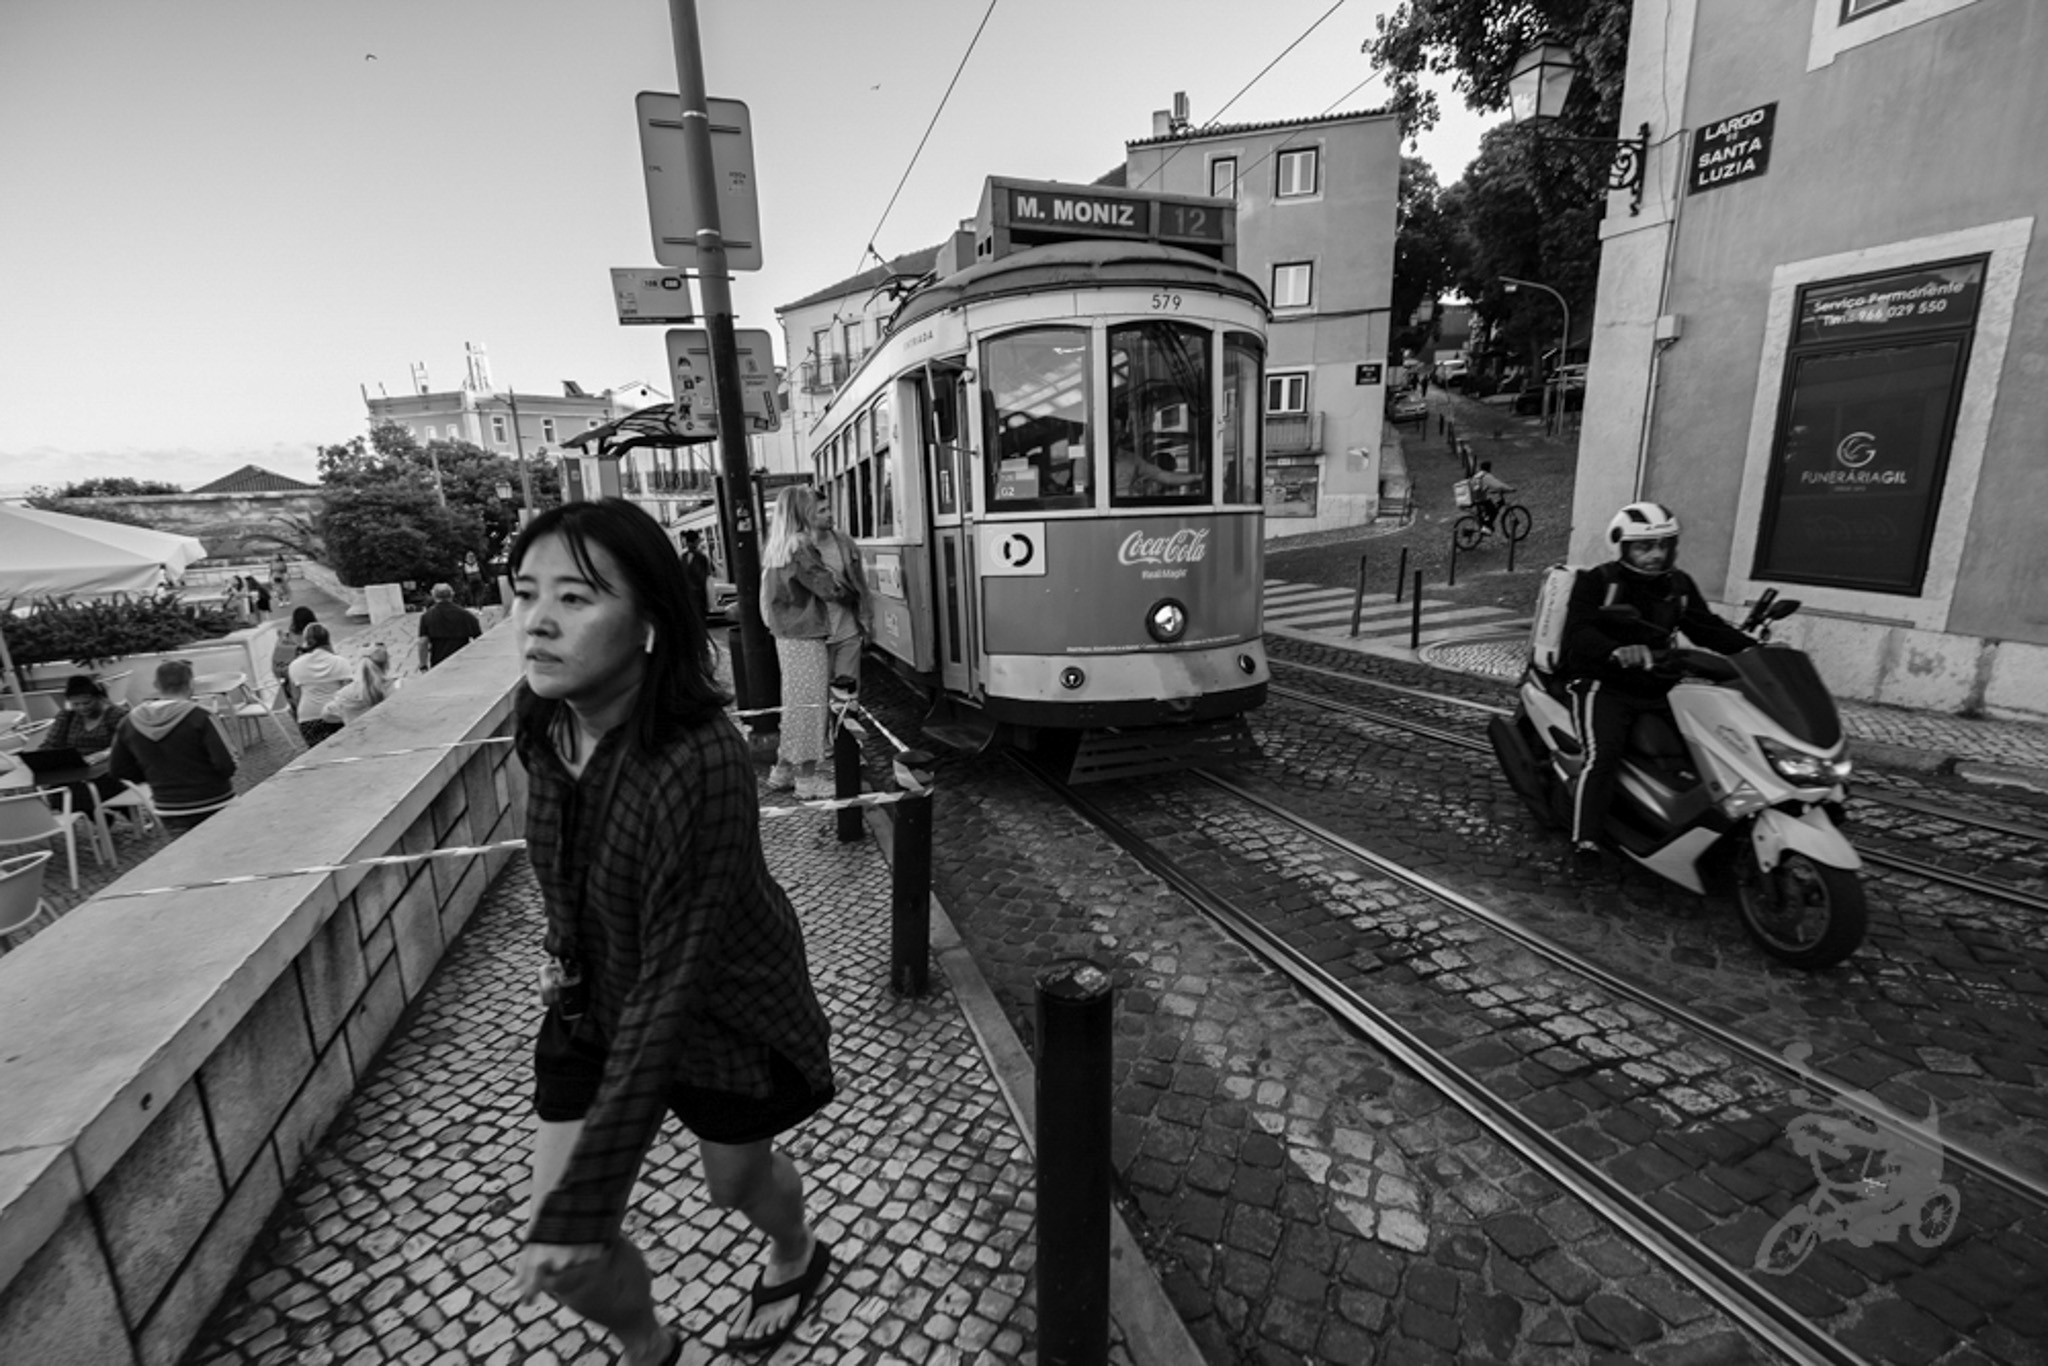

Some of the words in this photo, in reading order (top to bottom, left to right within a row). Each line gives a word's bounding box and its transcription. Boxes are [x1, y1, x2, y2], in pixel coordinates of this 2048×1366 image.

[1704, 109, 1765, 141] LARGO
[1698, 137, 1762, 169] SANTA
[1698, 157, 1756, 186] LUZIA
[1016, 196, 1046, 219] M.
[1053, 199, 1134, 226] MONIZ
[1174, 207, 1207, 236] 12
[1151, 294, 1182, 311] 579
[1858, 307, 1883, 321] 966
[1886, 303, 1915, 318] 029
[1917, 298, 1948, 315] 550
